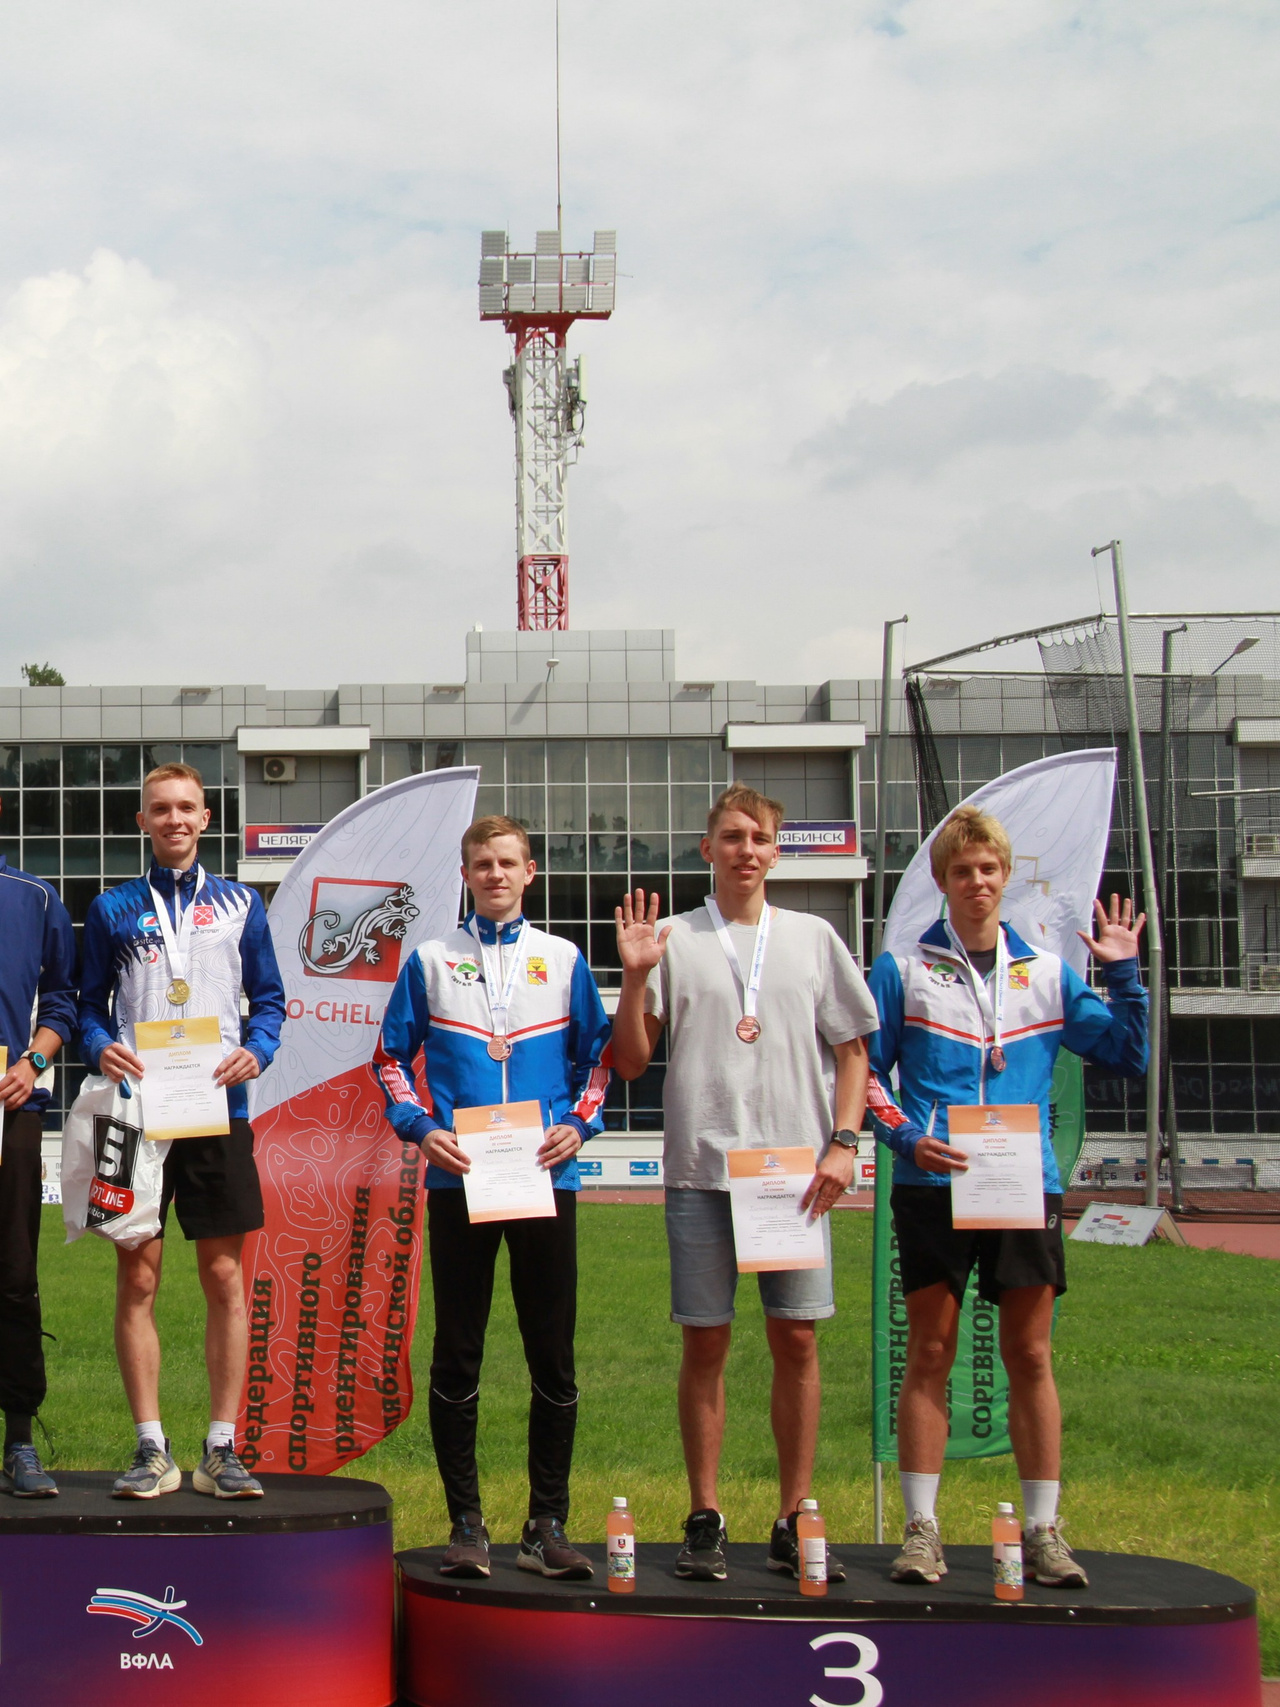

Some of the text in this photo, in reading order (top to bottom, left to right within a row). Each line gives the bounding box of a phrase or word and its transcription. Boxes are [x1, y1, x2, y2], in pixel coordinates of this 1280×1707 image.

[236, 1277, 274, 1472] Федерация
[287, 1252, 322, 1472] спортивного
[334, 1184, 371, 1460] риентирования
[373, 1252, 411, 1437] лябинской
[971, 1258, 994, 1439] СОРЕВНОВ
[120, 1651, 174, 1670] ВФЛА
[808, 1631, 884, 1707] 3
